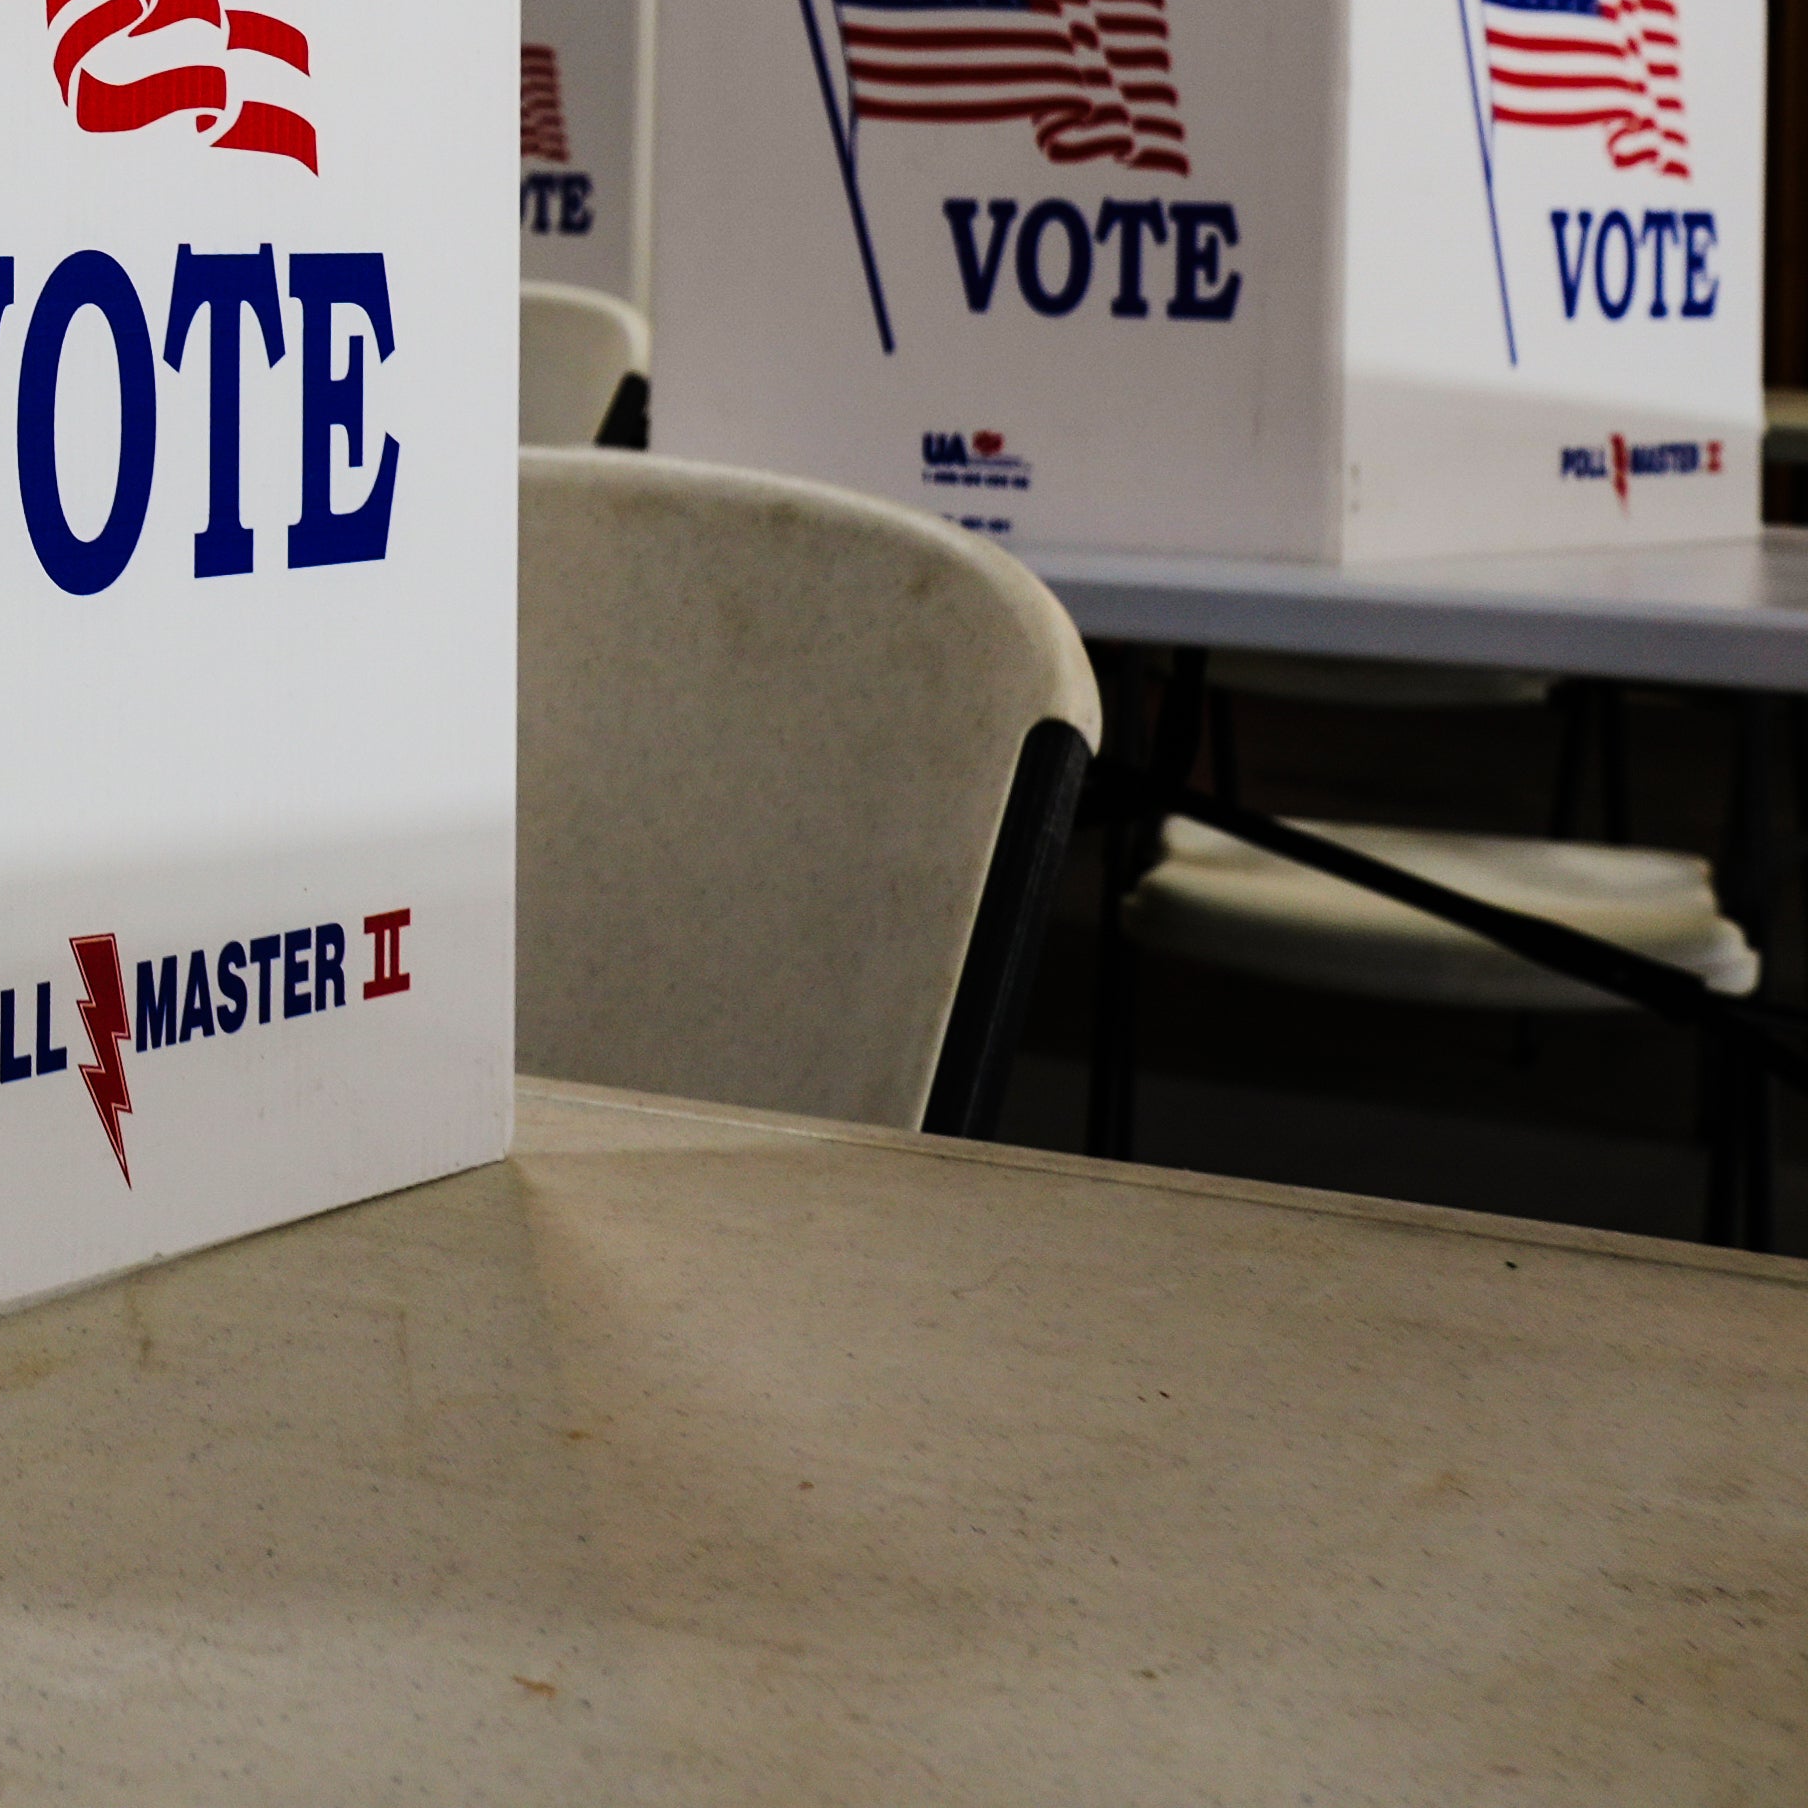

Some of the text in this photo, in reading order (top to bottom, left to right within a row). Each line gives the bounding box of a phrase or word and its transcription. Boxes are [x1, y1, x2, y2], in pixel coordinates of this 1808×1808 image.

[942, 196, 1243, 323] VOTE
[1549, 208, 1719, 321] VOTE
[135, 922, 347, 1053] MASTER
[362, 907, 412, 1001] II
